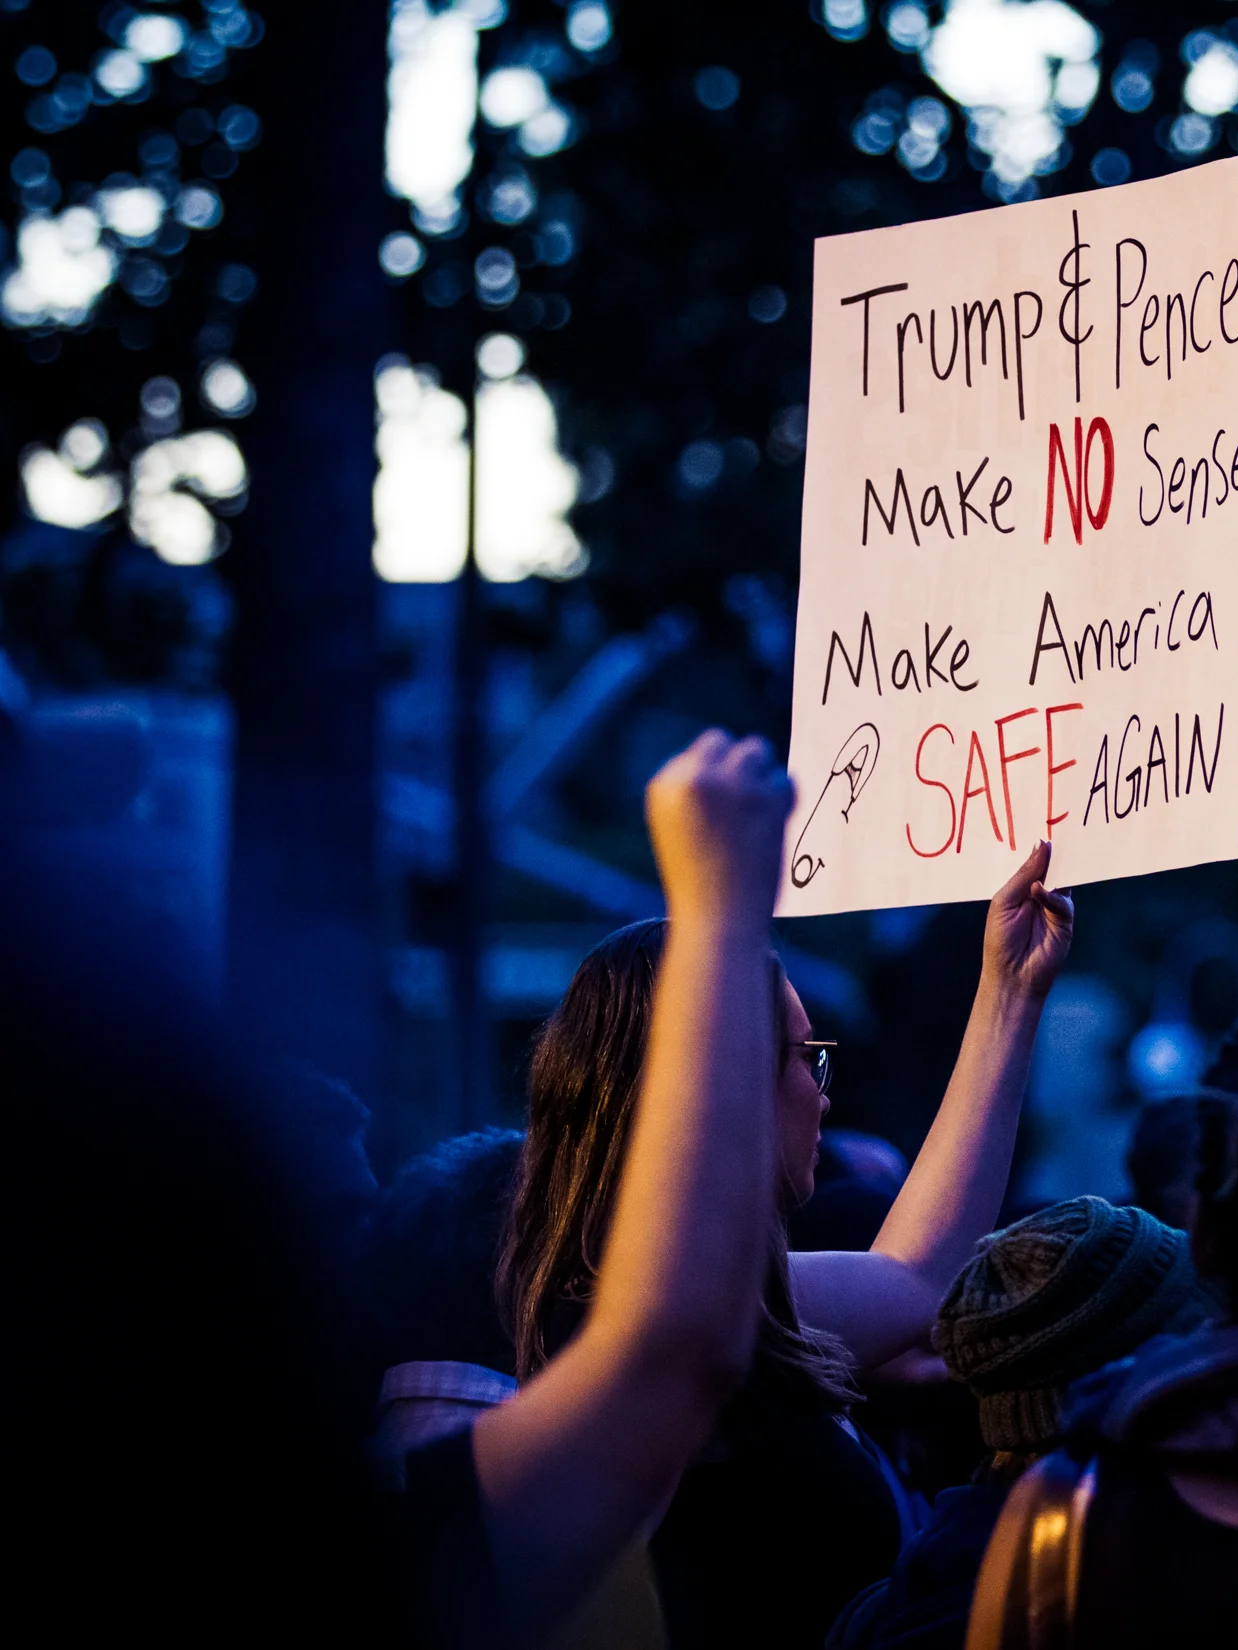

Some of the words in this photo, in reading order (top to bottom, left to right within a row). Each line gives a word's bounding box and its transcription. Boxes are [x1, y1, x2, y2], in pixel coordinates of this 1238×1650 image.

[840, 282, 1043, 421] Trump
[1057, 209, 1094, 403] &
[862, 455, 1015, 547] Make
[1043, 416, 1115, 546] NO
[821, 610, 980, 706] Make
[1029, 589, 1219, 687] America
[905, 702, 1084, 859] SAFE
[1083, 702, 1225, 827] AGAIN
